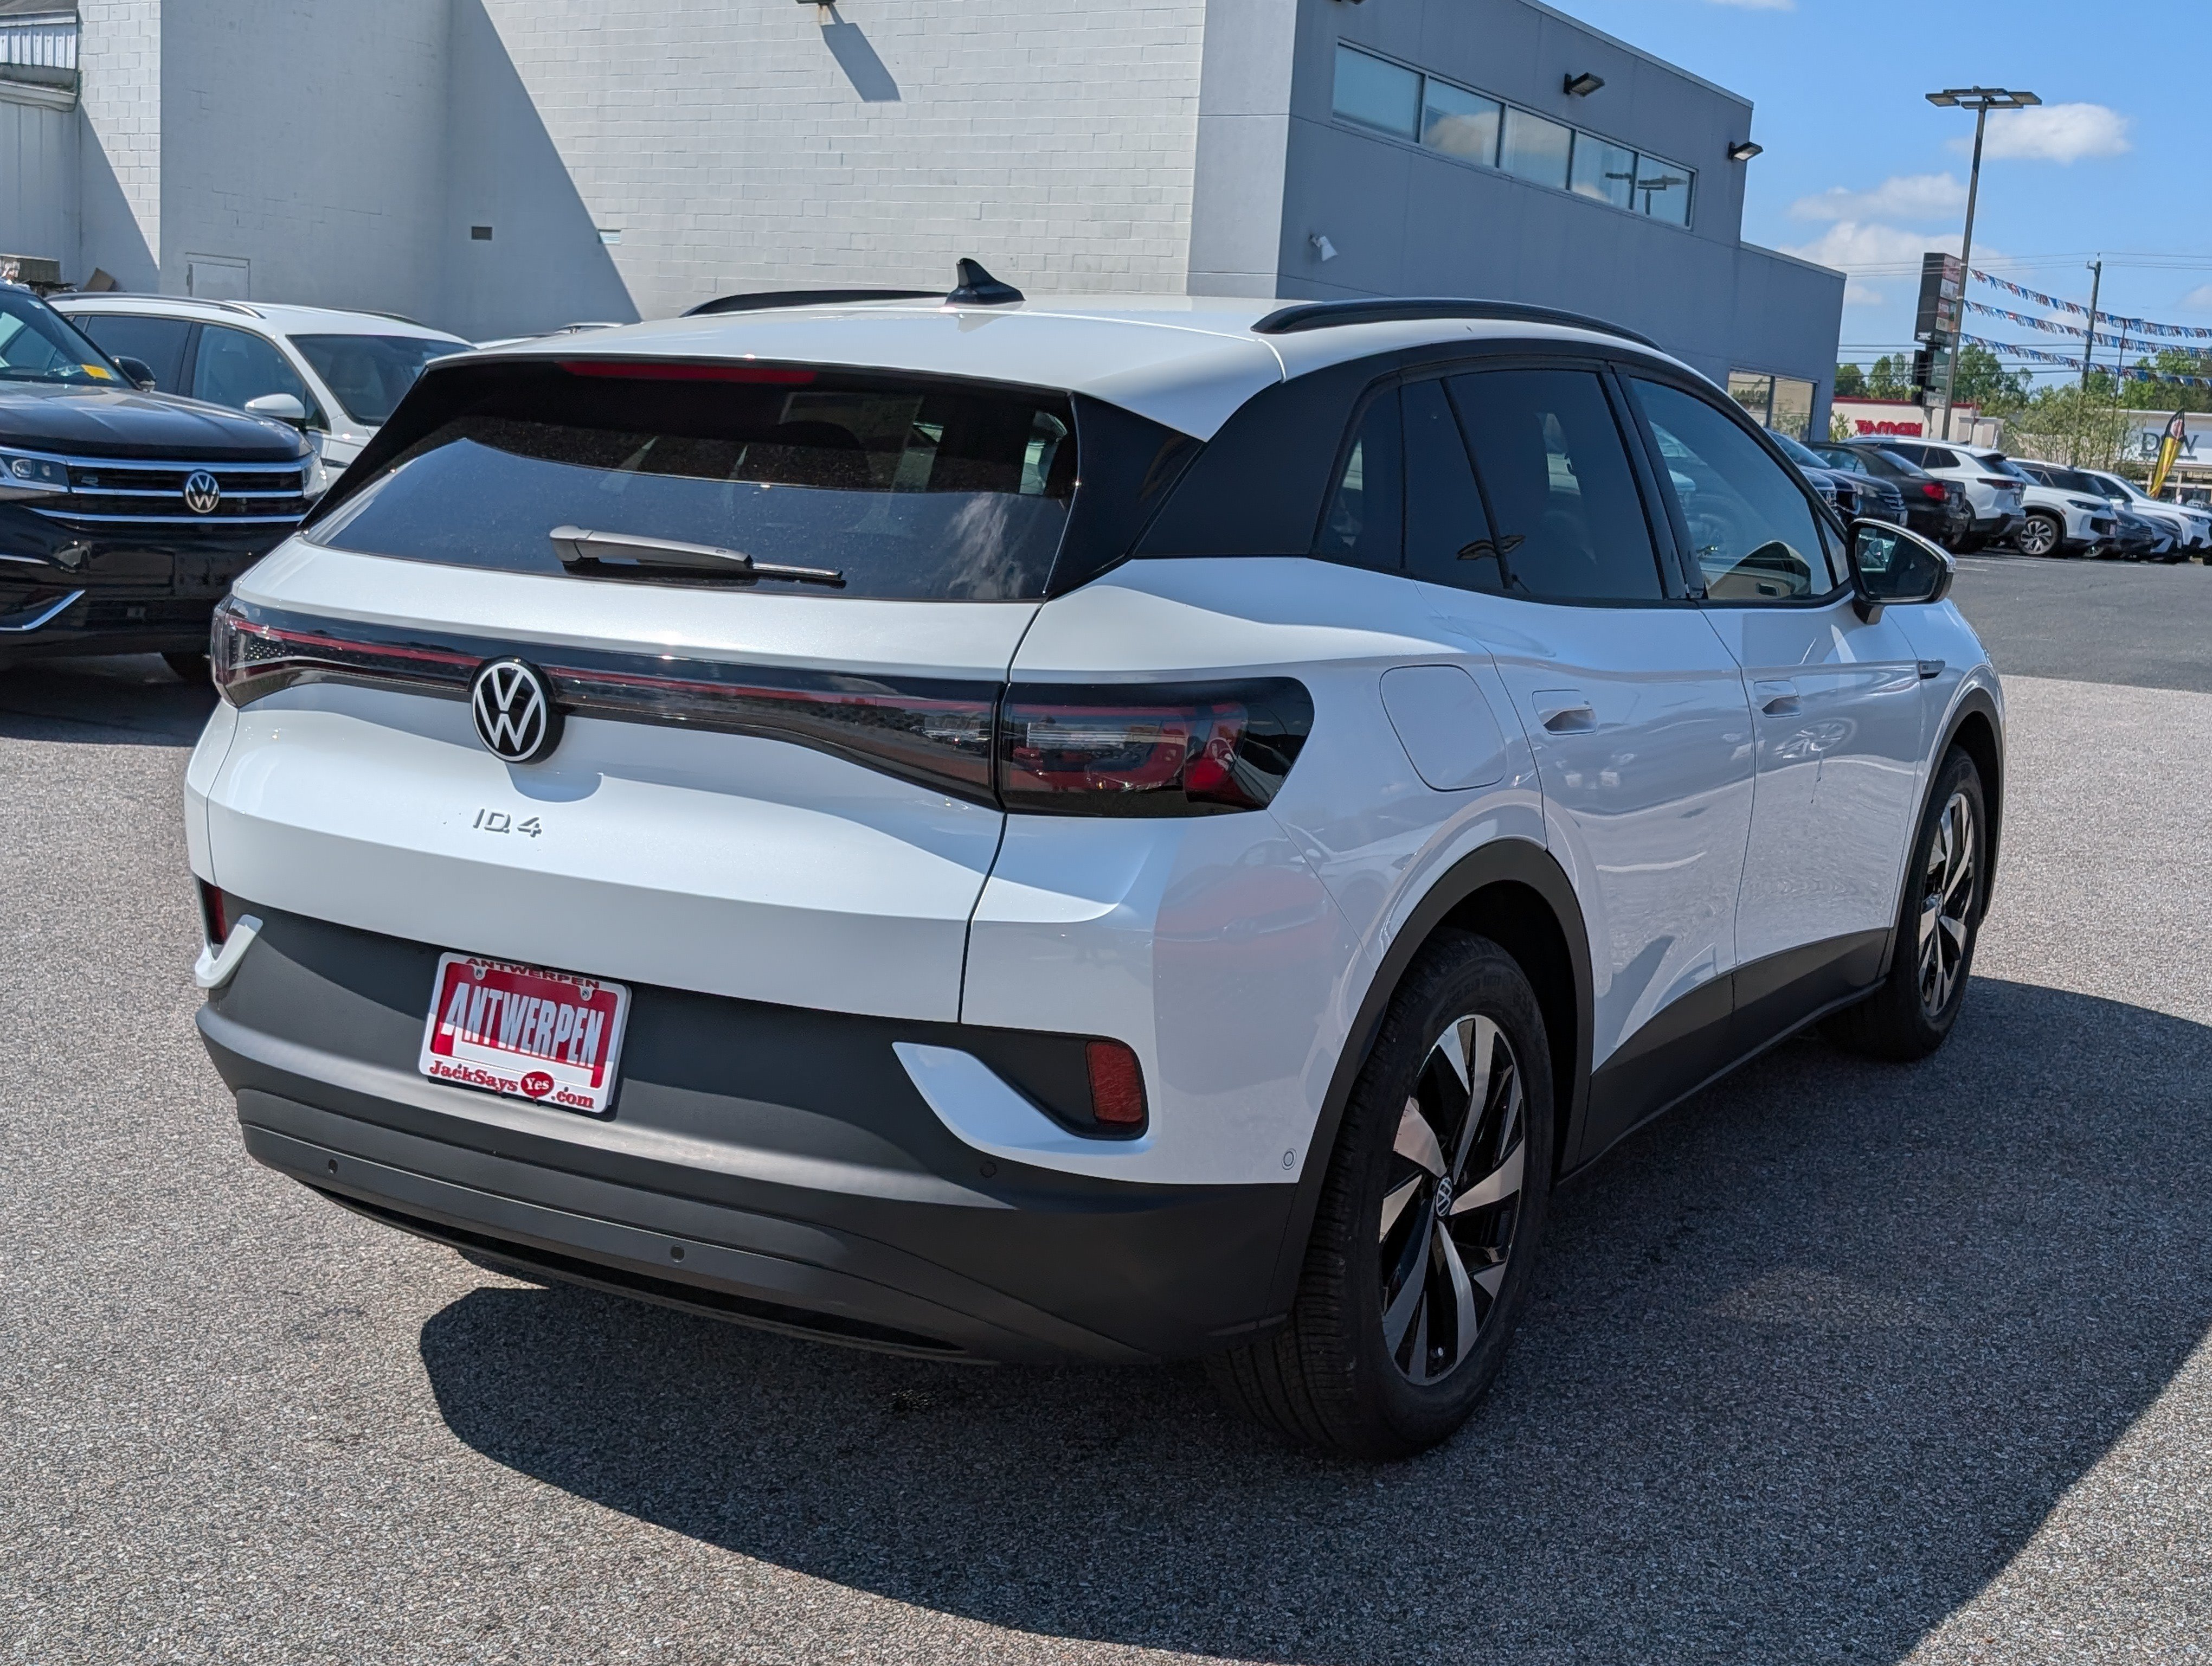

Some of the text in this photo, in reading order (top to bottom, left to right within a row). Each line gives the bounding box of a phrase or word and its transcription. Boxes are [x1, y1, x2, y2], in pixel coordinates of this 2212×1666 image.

[473, 662, 546, 760] VW
[466, 957, 600, 989] ANTWERPEN
[440, 982, 605, 1068] ANTWERPEN
